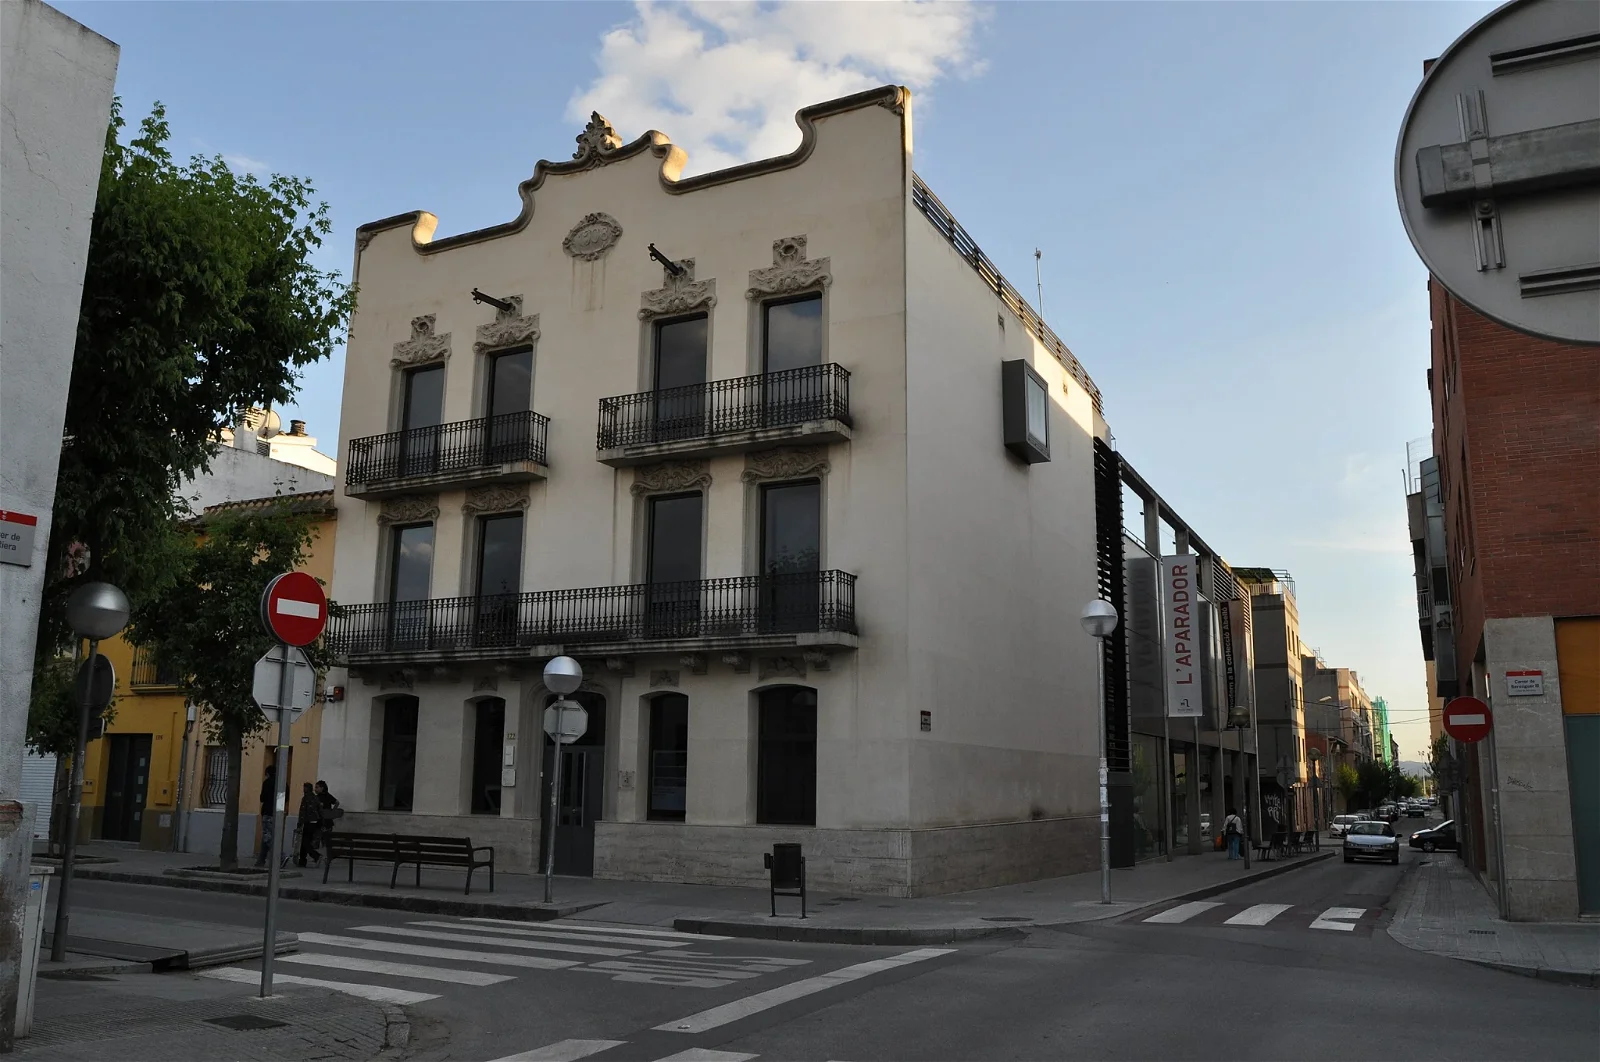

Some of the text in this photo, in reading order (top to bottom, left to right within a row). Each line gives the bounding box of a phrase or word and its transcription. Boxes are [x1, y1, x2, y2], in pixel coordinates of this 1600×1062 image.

[11, 533, 21, 541] de
[1172, 564, 1193, 685] L'APARADOR
[1221, 607, 1230, 630] Abelló
[568, 950, 814, 988] STOP
